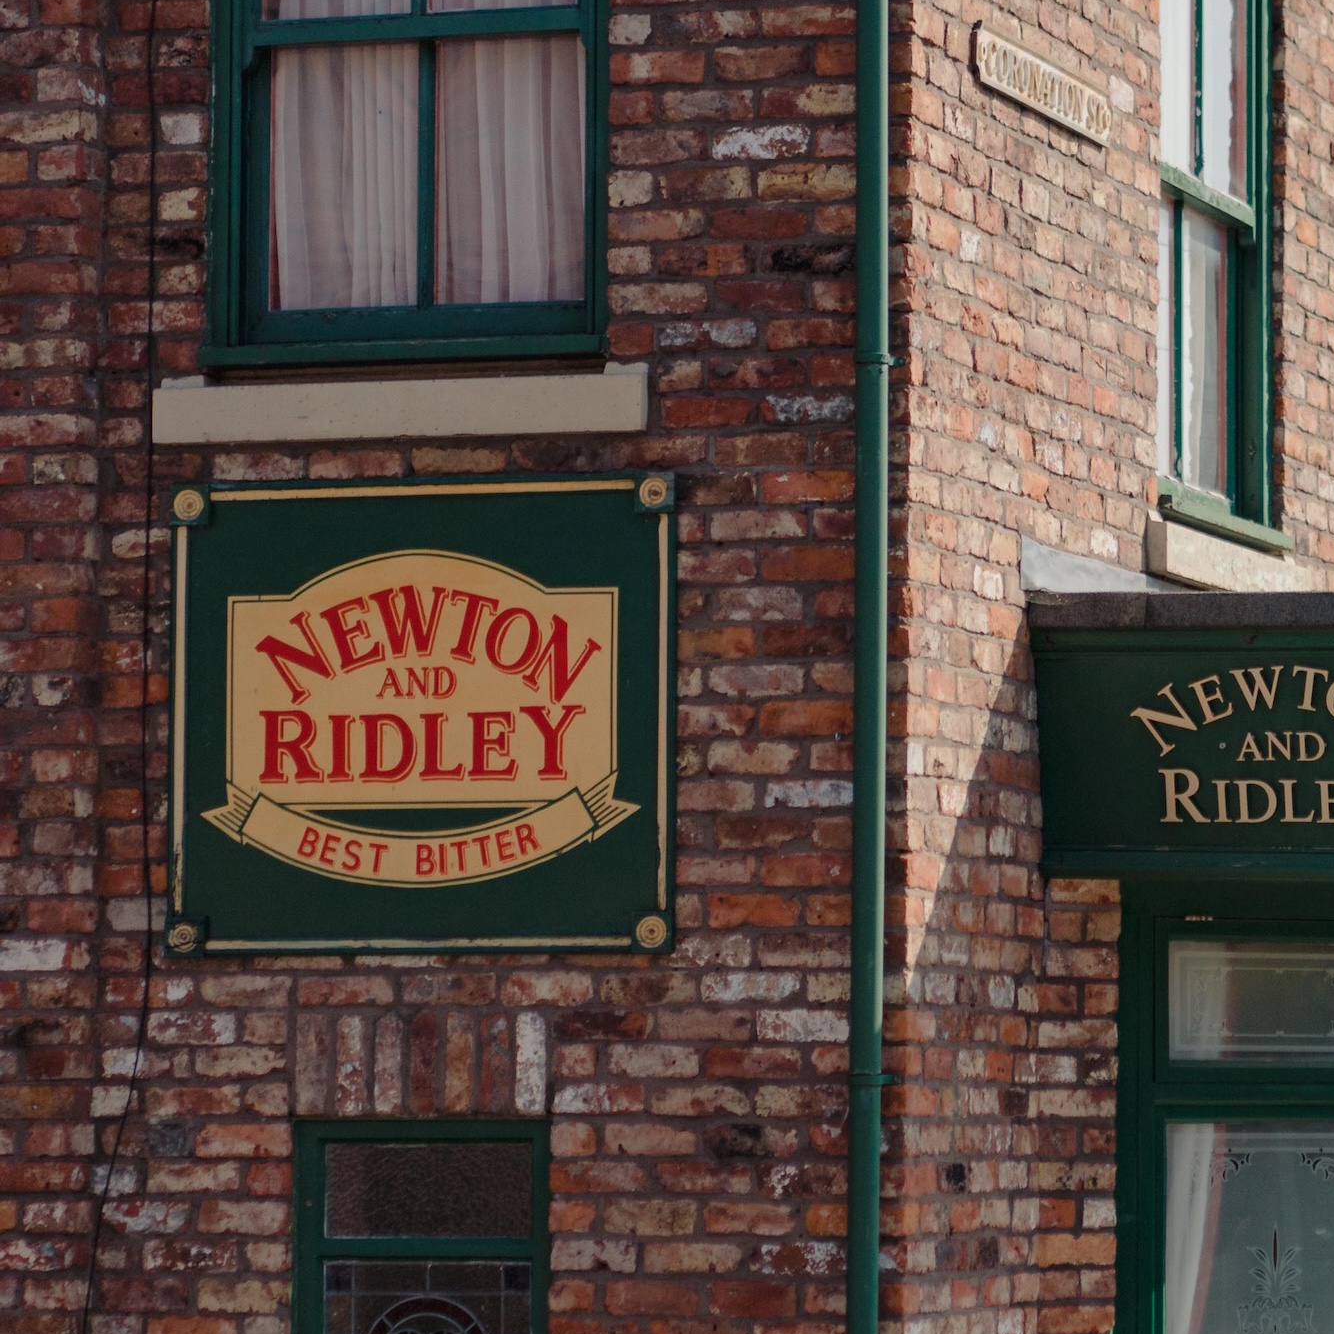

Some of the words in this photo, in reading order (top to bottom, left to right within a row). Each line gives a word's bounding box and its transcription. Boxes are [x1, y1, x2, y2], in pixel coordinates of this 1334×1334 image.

[985, 40, 1083, 124] CORONATION
[255, 585, 602, 705] NEWTON
[376, 667, 457, 699] AND
[259, 704, 586, 784] RIDLEY
[1236, 731, 1326, 762] AND
[297, 826, 390, 875] BEST
[415, 822, 543, 877] BITTER
